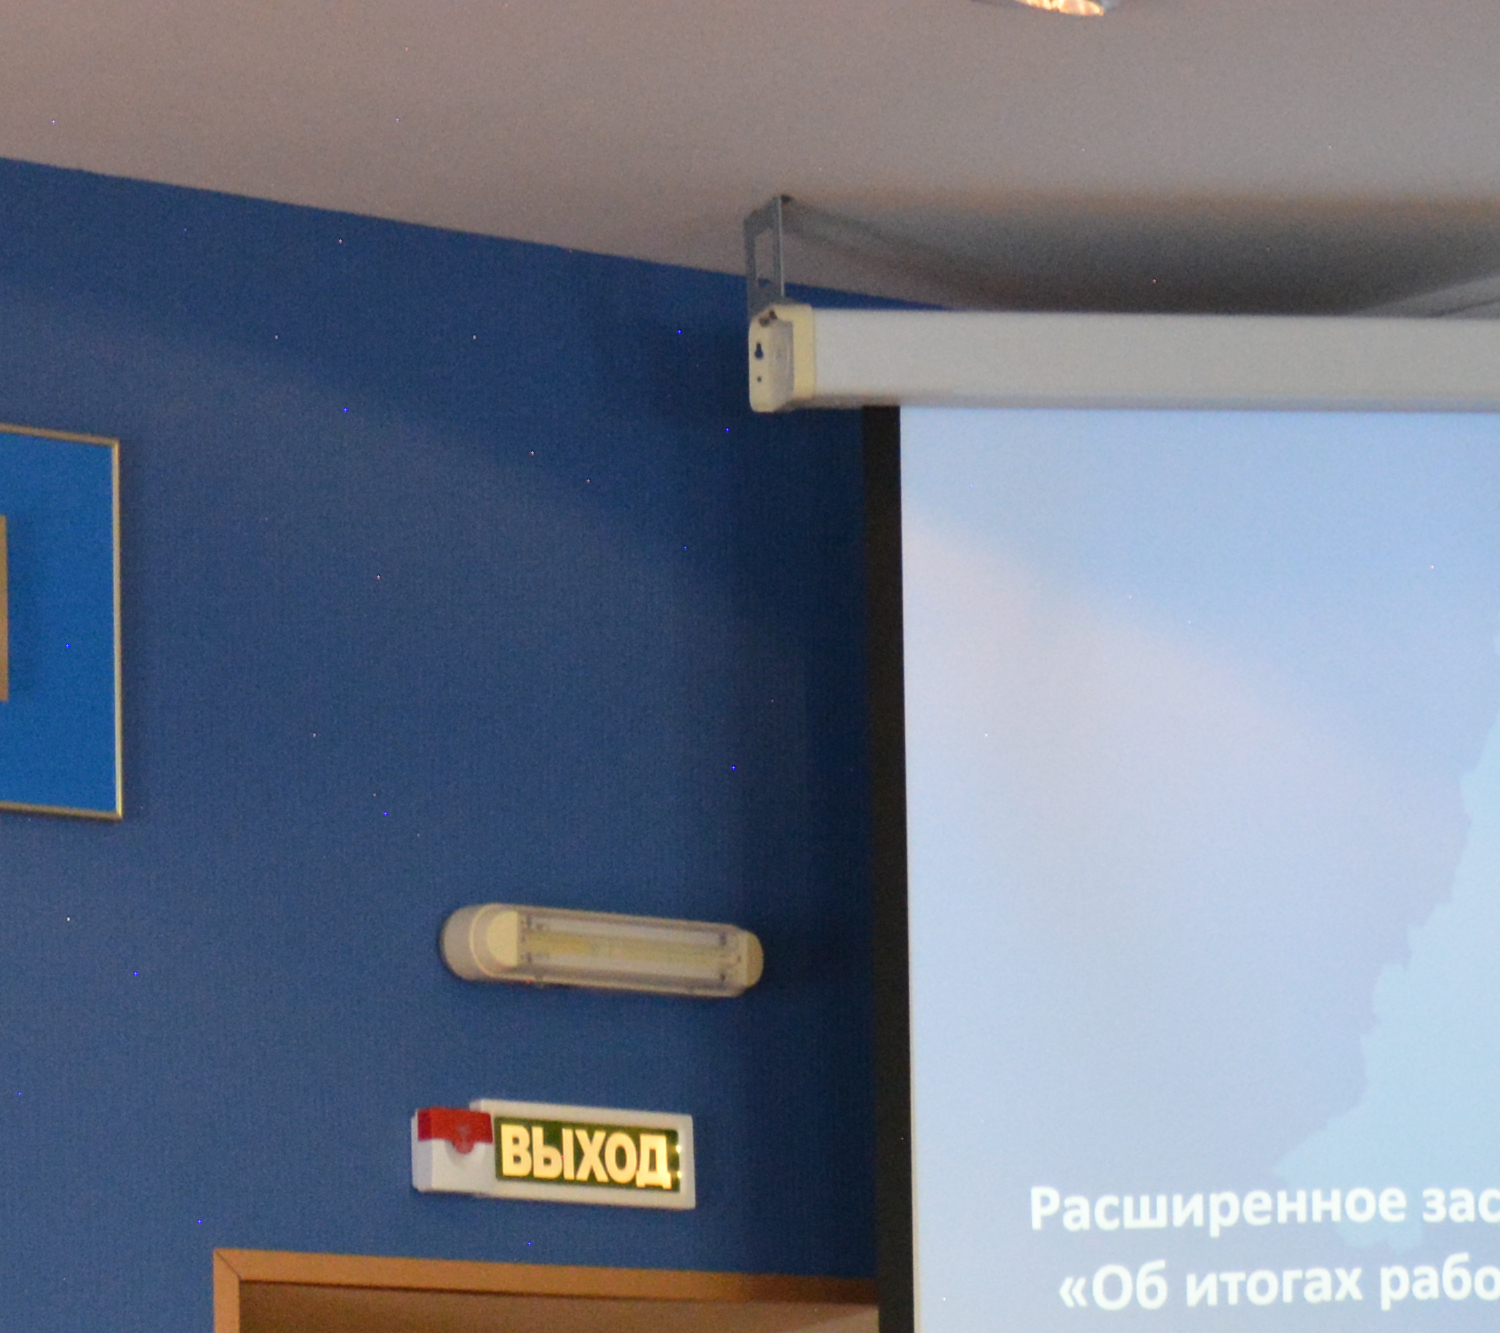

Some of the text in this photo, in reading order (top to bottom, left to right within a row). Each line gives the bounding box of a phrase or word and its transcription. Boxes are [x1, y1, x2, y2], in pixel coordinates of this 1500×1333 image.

[501, 1124, 673, 1189] ВЫХОД
[1031, 1187, 1406, 1237] Расширенное
[1059, 1260, 1167, 1311] «Об
[1186, 1266, 1363, 1306] итогах
